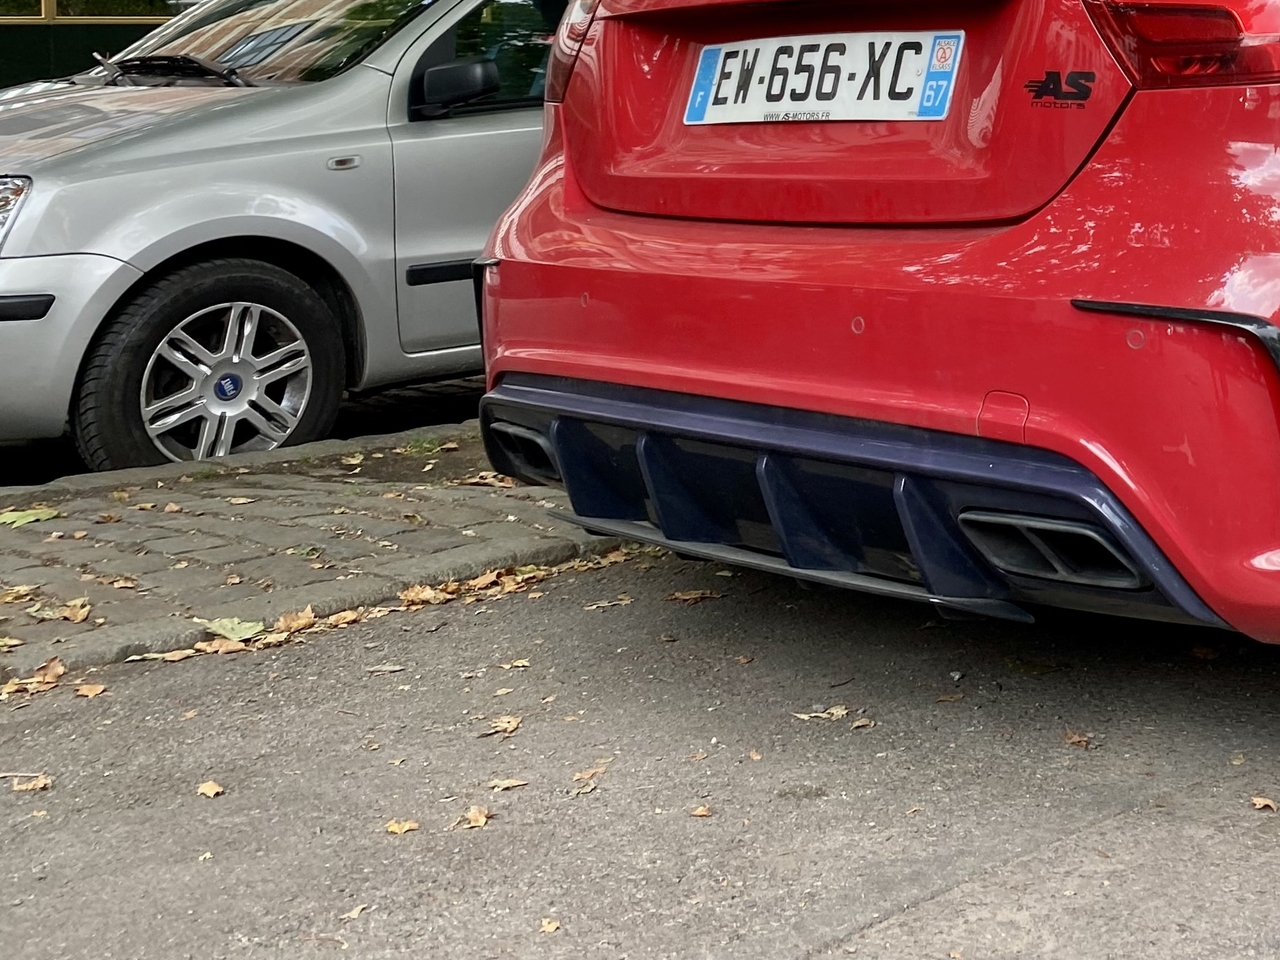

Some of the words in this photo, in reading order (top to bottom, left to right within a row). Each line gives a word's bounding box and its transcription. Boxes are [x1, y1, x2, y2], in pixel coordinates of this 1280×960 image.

[712, 41, 923, 106] EW-656-XC
[923, 80, 948, 107] 67
[1024, 71, 1096, 101] AS
[695, 91, 704, 108] F
[1031, 101, 1085, 110] motors
[220, 378, 236, 396] FIAT
